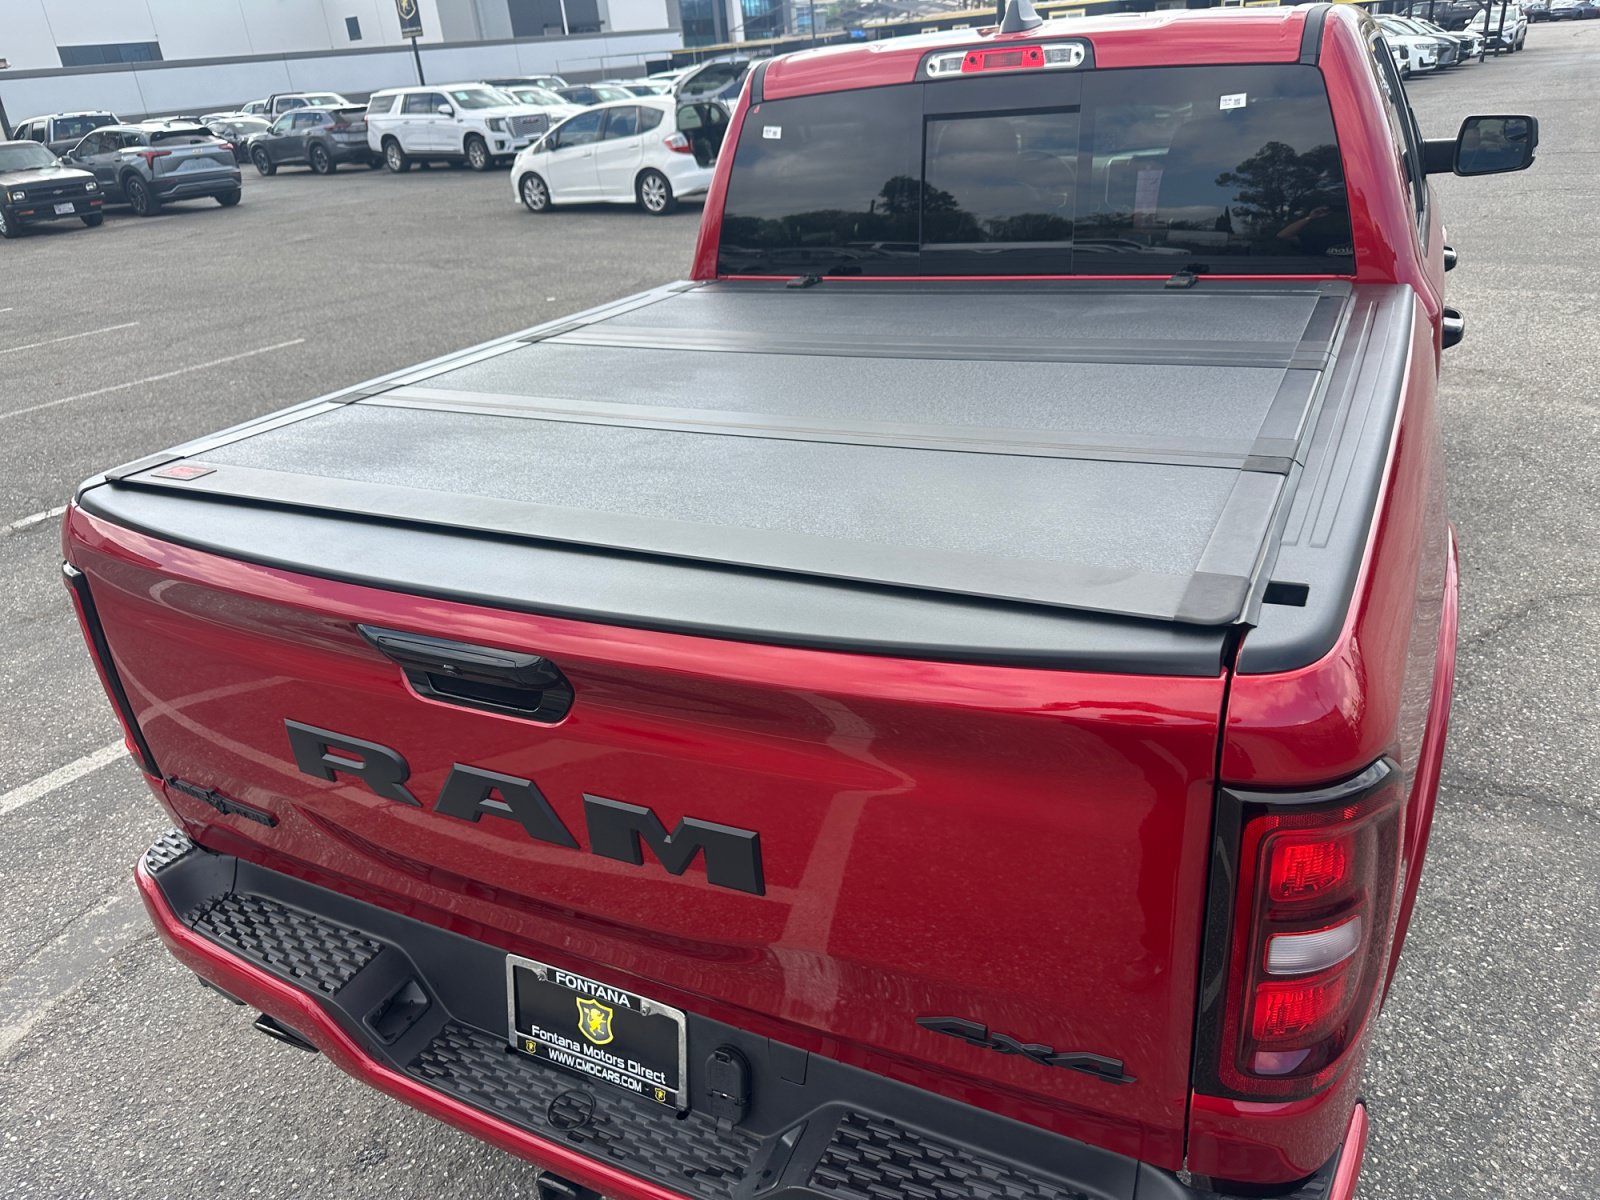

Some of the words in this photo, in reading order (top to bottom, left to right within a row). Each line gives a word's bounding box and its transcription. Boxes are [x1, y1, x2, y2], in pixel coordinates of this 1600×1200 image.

[284, 718, 765, 897] RAM
[555, 971, 631, 1008] FONTANA
[531, 1024, 581, 1052] Fontana
[583, 1045, 625, 1068] Motors
[628, 1059, 666, 1085] Direct
[548, 1047, 642, 1093] WWW.CMDCARS.COM
